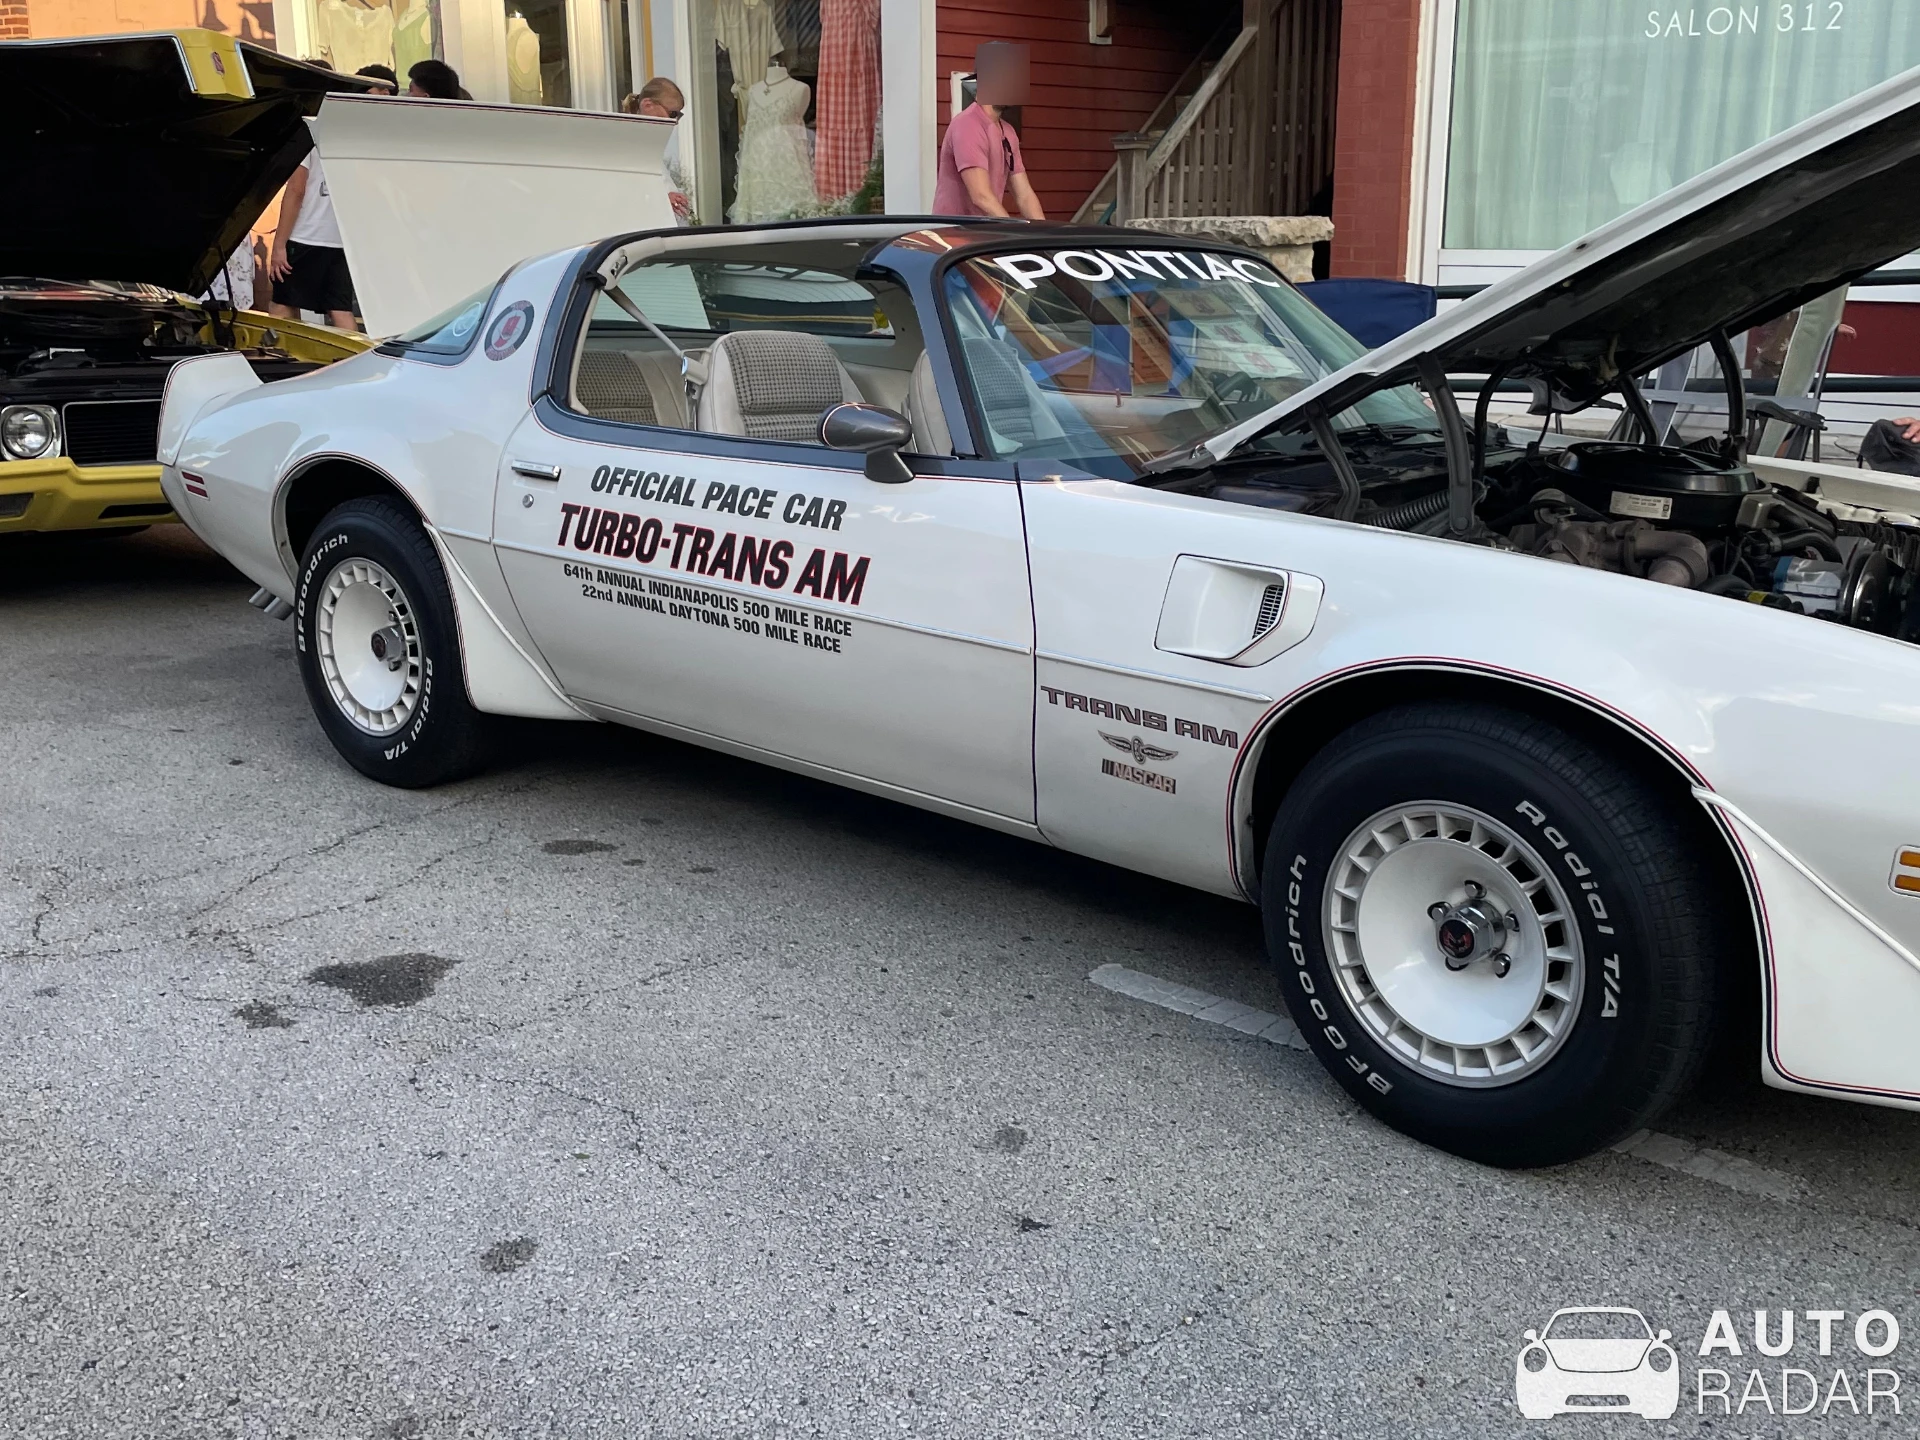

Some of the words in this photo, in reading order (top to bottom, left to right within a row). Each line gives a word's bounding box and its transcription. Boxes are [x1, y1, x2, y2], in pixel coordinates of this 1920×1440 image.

[1644, 5, 1760, 38] SALON
[1776, 1, 1844, 32] 312
[993, 249, 1281, 290] PONTIAC
[590, 464, 697, 507] OFFICIAL
[701, 480, 778, 520] PACE
[782, 492, 848, 532] CAR
[557, 502, 794, 590] TURBO-TRANS
[793, 548, 871, 606] AM
[563, 563, 594, 582] 64th
[597, 569, 646, 593] ANNUAL
[648, 579, 739, 613] INDIANAPOLIS
[743, 600, 770, 619] 500
[775, 606, 809, 628] MILE
[814, 614, 853, 637] RACE
[581, 584, 613, 603] 22nd
[616, 590, 666, 615] ANNUAL
[669, 601, 730, 629] DAYTONA
[733, 617, 760, 635] 500
[765, 623, 799, 645] MILE
[803, 631, 842, 653] RACE
[411, 657, 433, 742] Radial
[1040, 685, 1168, 732] TRANS
[1174, 717, 1239, 749] AM
[383, 740, 409, 761] T/A
[1112, 760, 1174, 793] NASCAR
[1515, 800, 1616, 935] Radial
[1601, 953, 1622, 1018] T/A
